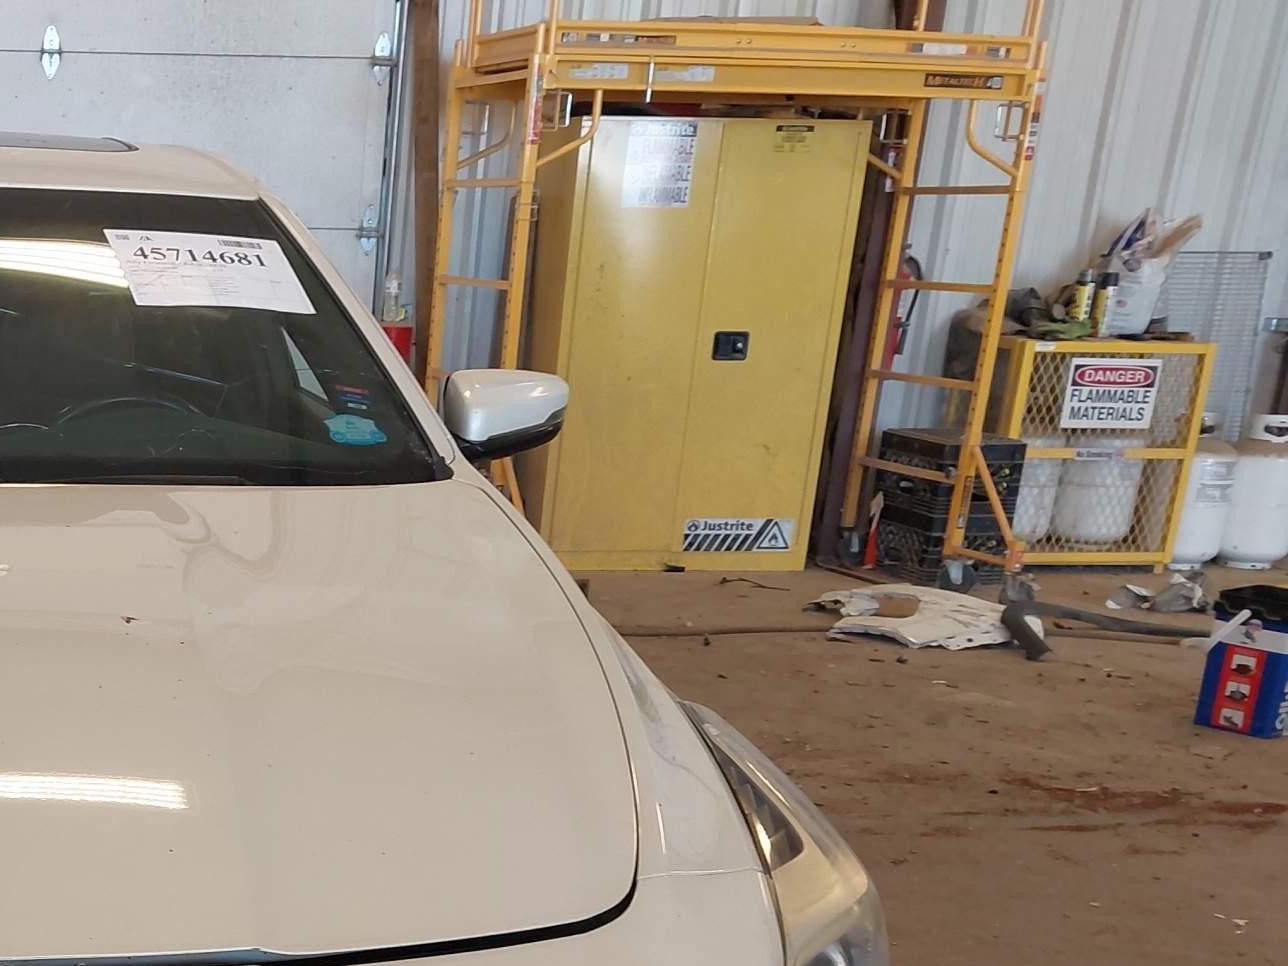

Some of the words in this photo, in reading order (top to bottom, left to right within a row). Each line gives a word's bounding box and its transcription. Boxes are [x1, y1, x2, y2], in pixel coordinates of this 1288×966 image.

[133, 246, 266, 268] 45714681
[1083, 369, 1146, 383] DANGER
[1069, 388, 1152, 404] FLAMMABLE
[1068, 405, 1145, 421] MATERIALS
[701, 520, 755, 532] Justrite
